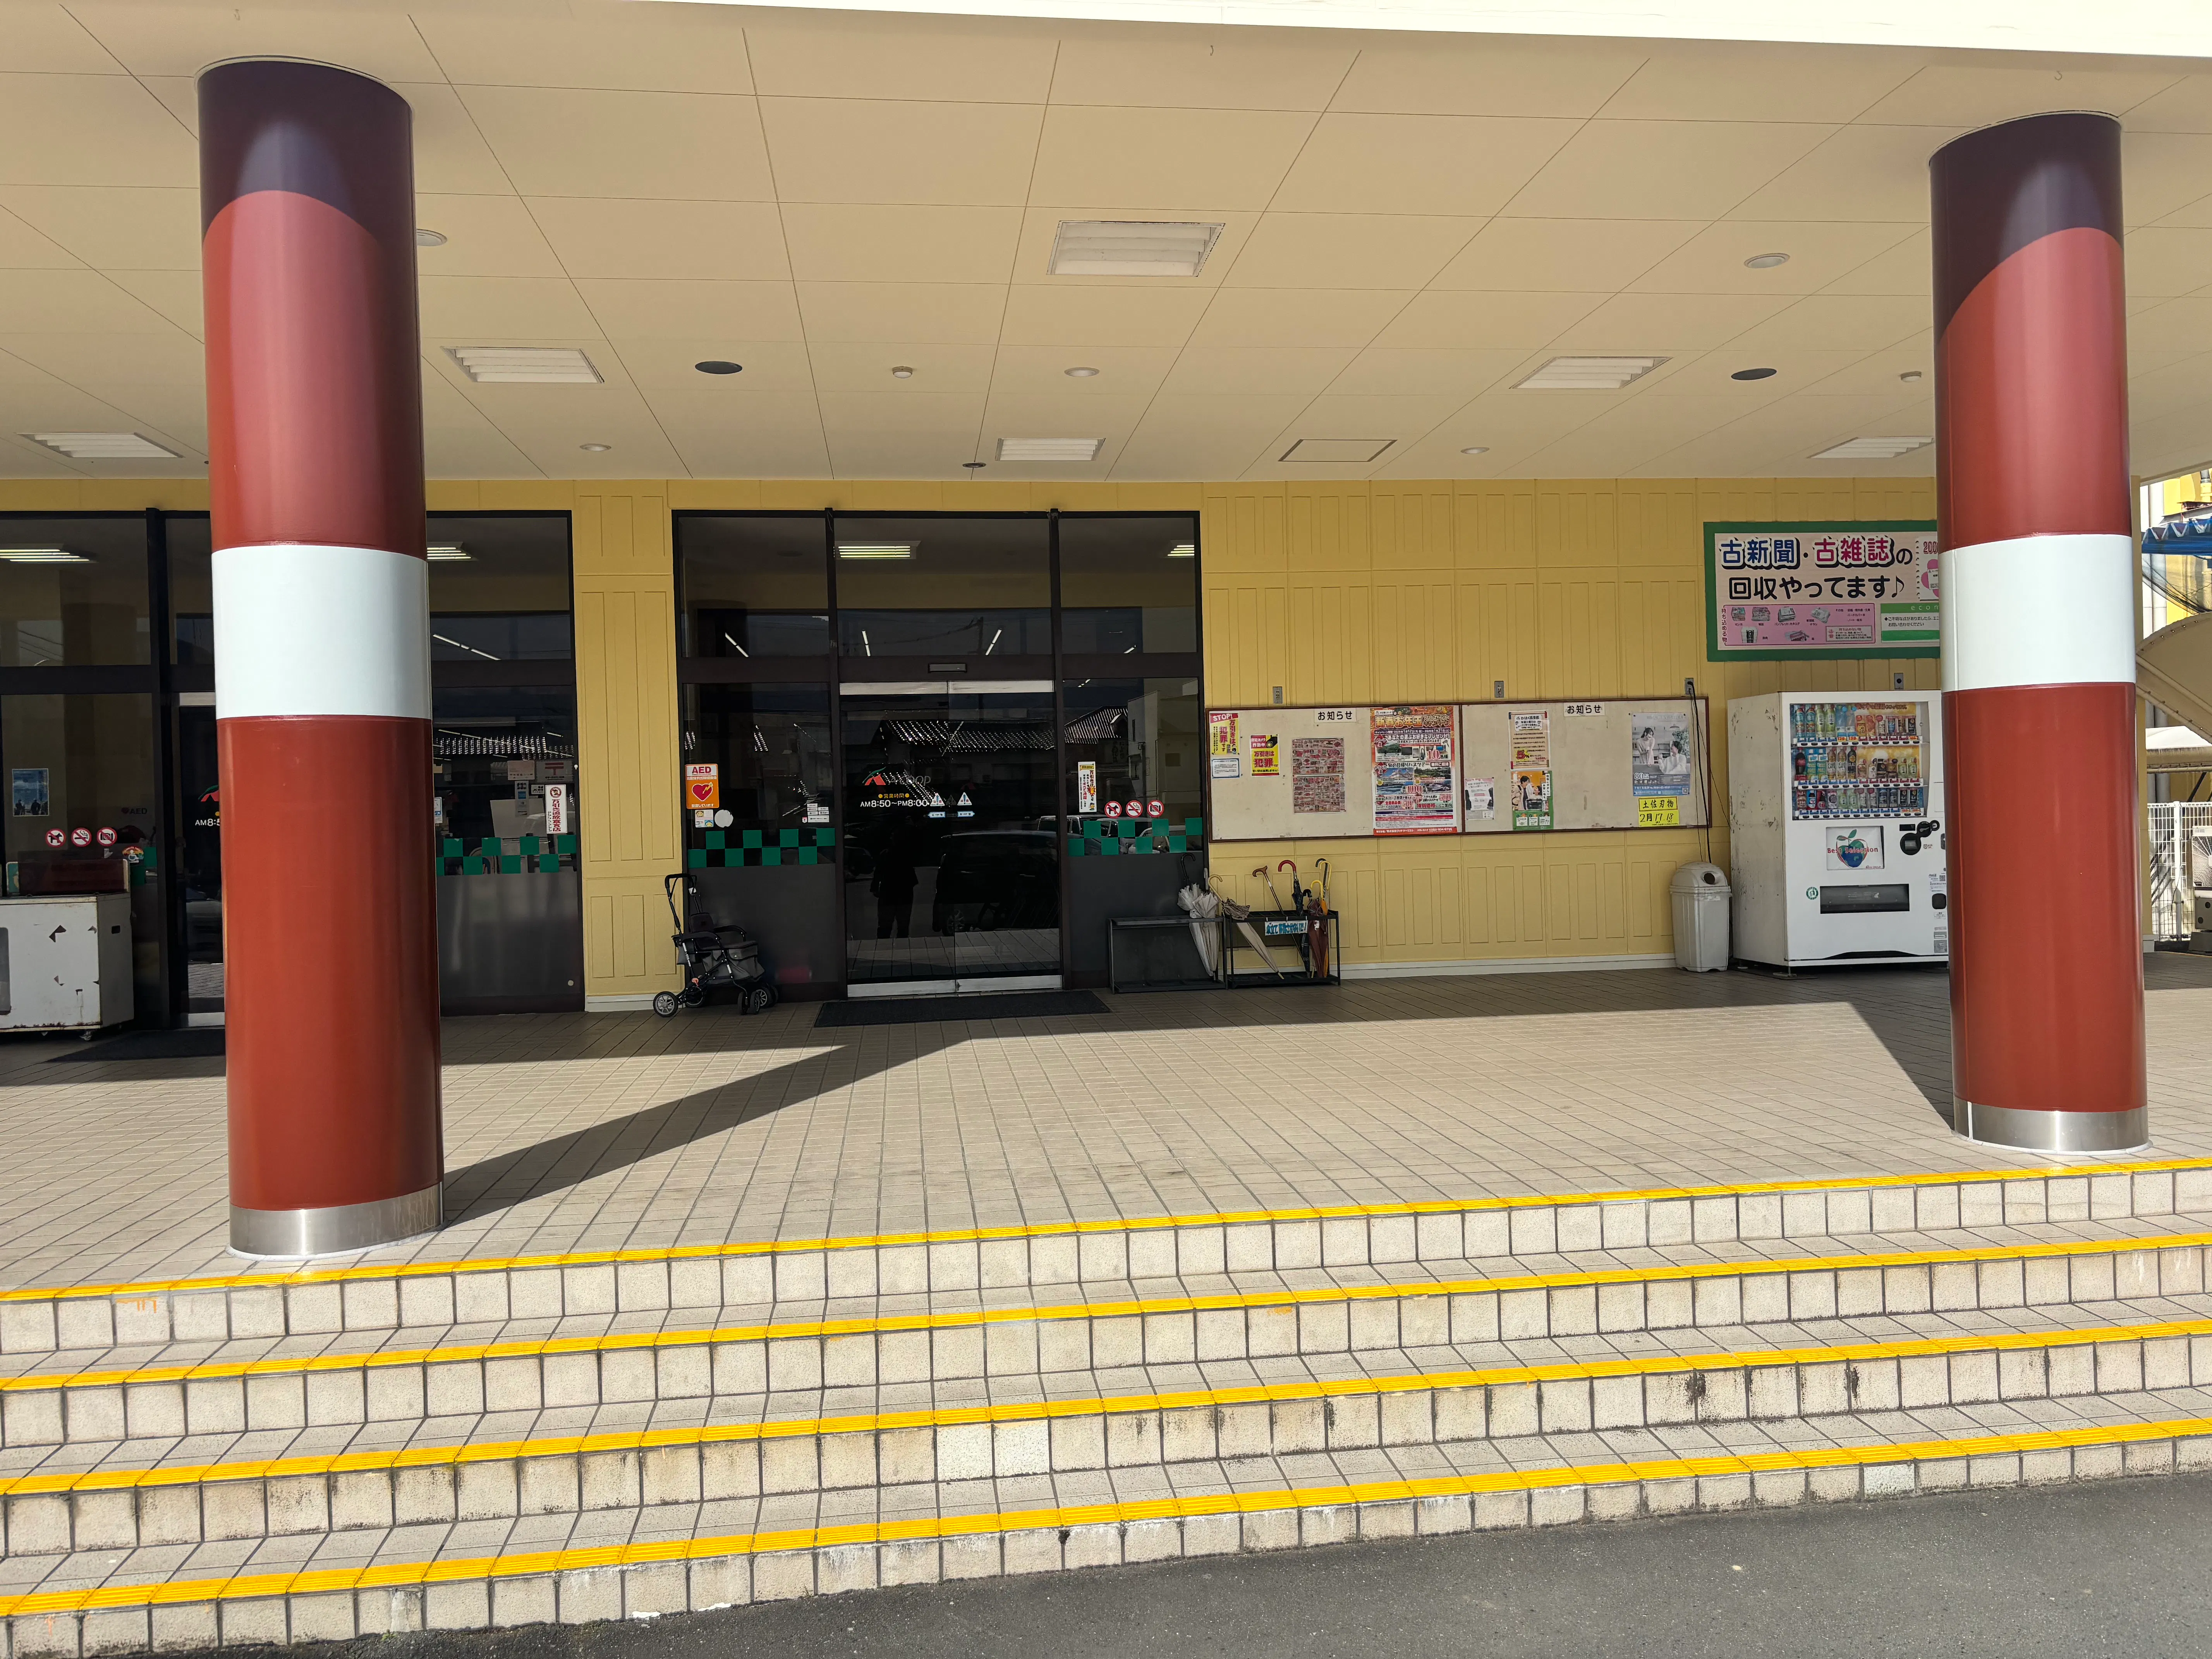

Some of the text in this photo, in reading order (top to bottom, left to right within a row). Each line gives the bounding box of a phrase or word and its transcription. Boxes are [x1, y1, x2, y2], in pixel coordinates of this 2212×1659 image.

[1720, 537, 1913, 566] 古新聞・古雑誌の
[1923, 541, 1938, 554] 200
[1318, 711, 1352, 720] お知らせ
[1567, 705, 1601, 714] お知らせ
[1376, 715, 1423, 728] 新春お年玉
